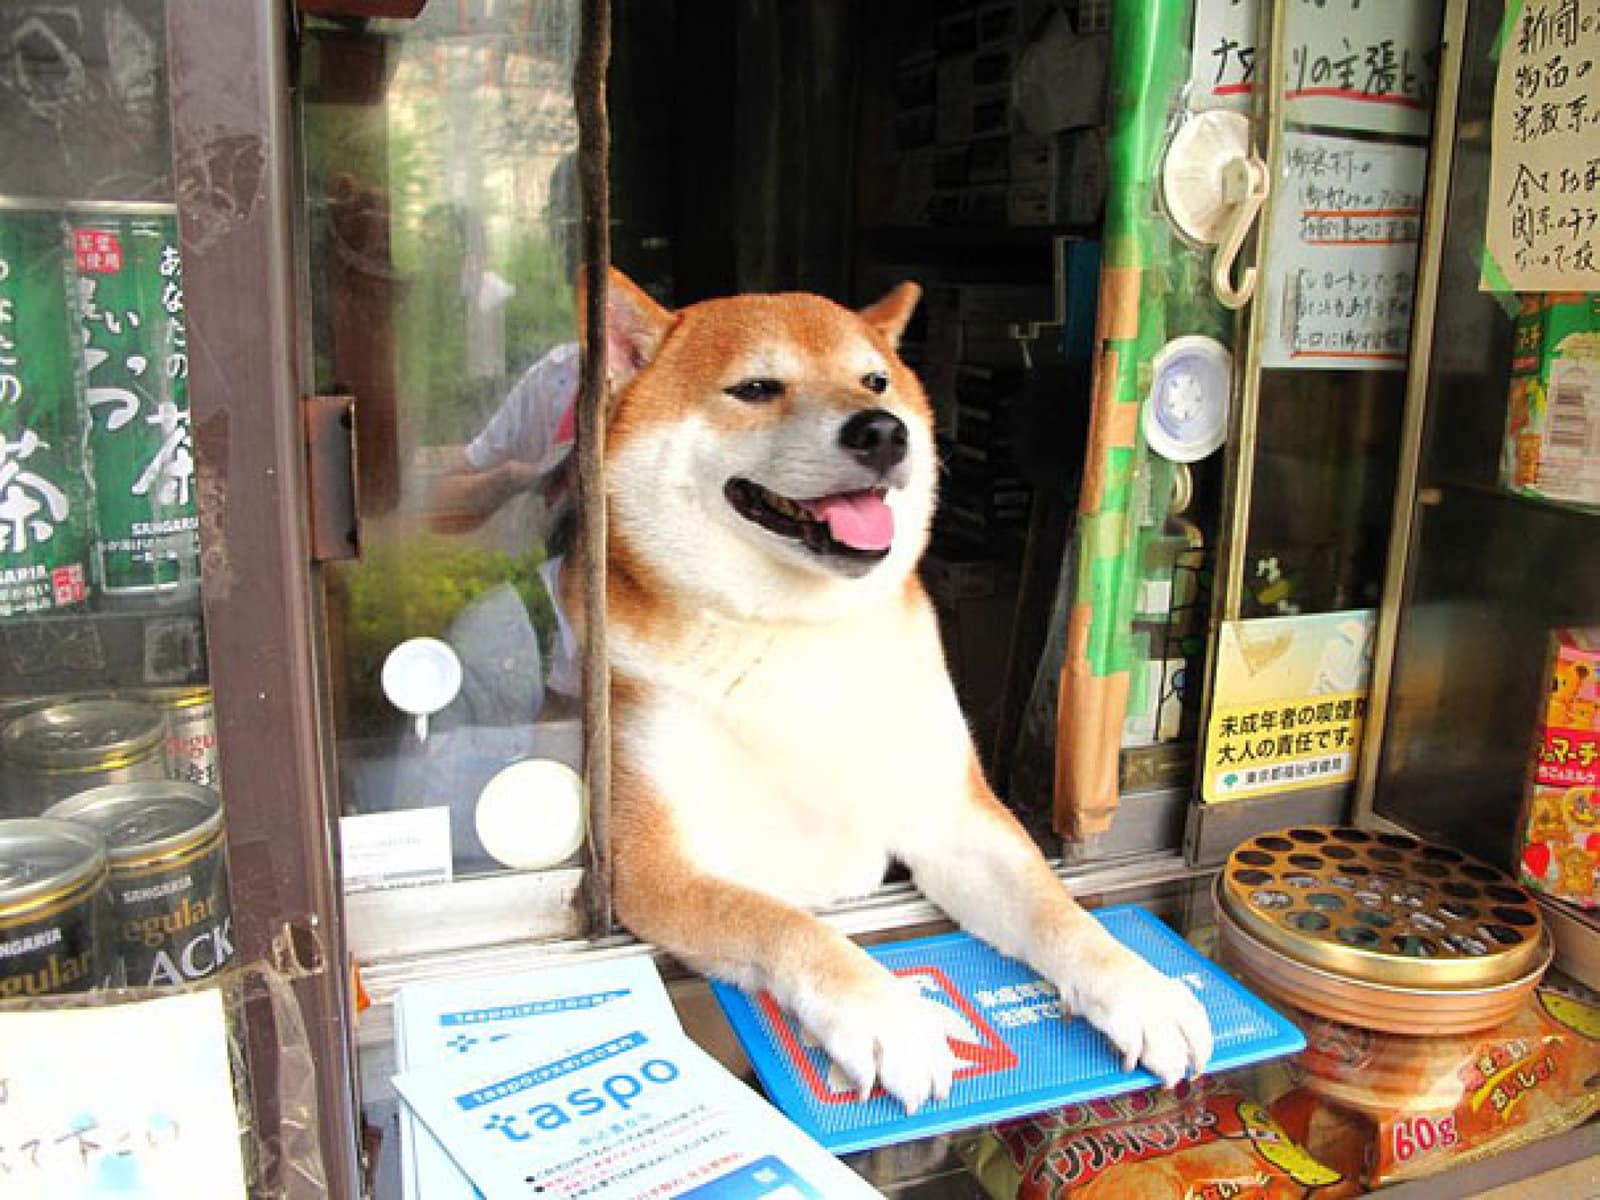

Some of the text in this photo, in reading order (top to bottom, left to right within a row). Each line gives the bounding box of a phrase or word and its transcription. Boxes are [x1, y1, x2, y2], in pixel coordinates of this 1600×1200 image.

[1216, 727, 1355, 765] 大人の責任です。
[483, 1058, 681, 1143] taspo
[1393, 1116, 1458, 1162] 60g
